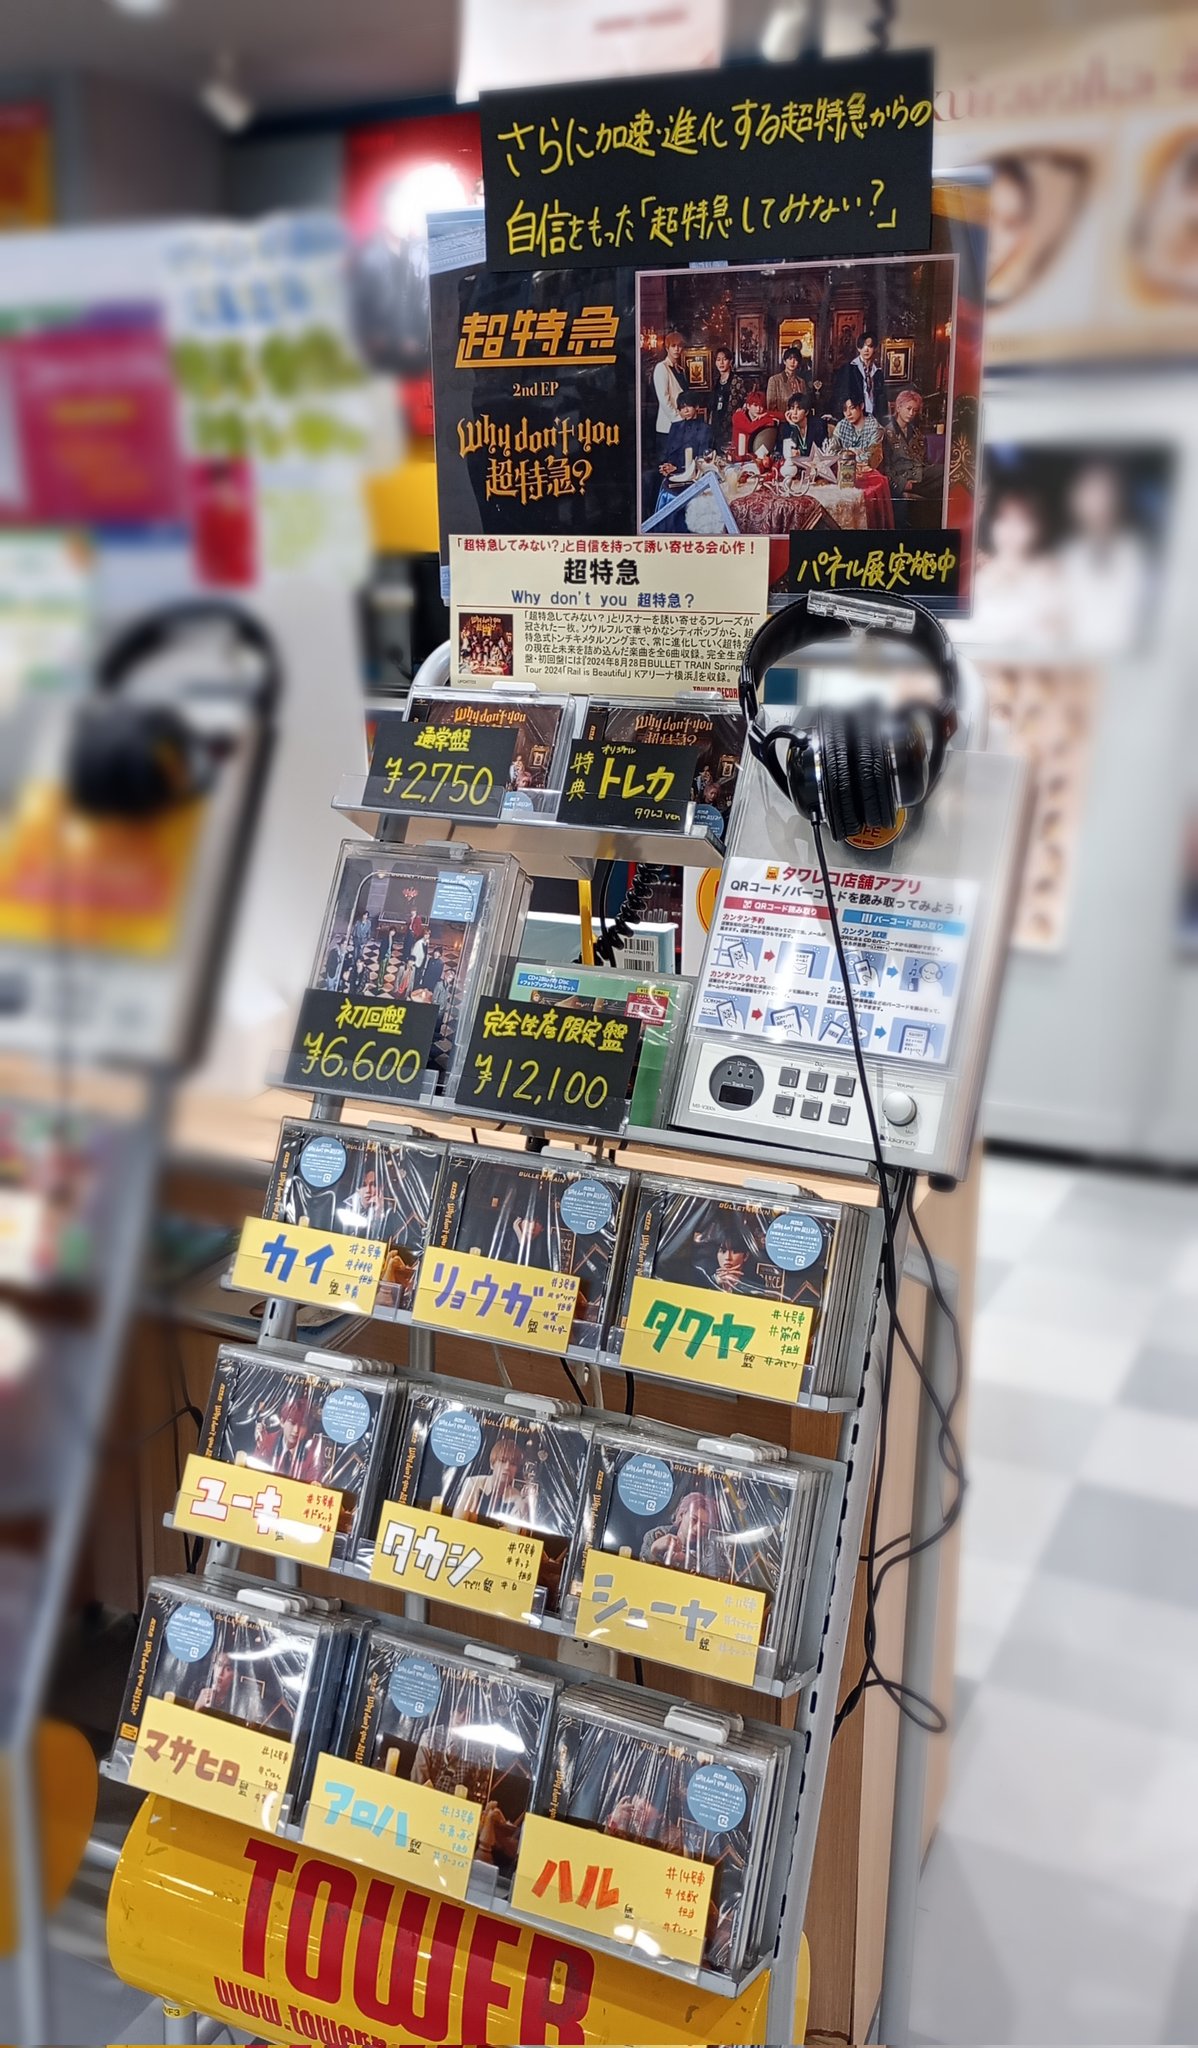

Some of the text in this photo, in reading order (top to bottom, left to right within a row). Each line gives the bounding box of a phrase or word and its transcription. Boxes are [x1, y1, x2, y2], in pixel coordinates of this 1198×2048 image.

[455, 306, 620, 368] 超特急
[512, 381, 560, 397] 2nd EP
[457, 413, 620, 459] Why don't you
[563, 558, 640, 585] 超特急
[797, 543, 956, 588] パネル展実施中
[511, 590, 695, 609] Why don't you 超特急？
[525, 665, 541, 674] Tour
[583, 667, 590, 676] is
[684, 661, 711, 670] TRAIN
[454, 706, 480, 724] Why
[414, 726, 474, 753] 通常盤
[383, 757, 494, 807] ¥2,750
[566, 750, 596, 802] 特典
[598, 757, 676, 802] トレカ
[783, 866, 923, 894] タワレコ店舗アプリ
[710, 970, 766, 984] カンタンアクセス
[829, 986, 876, 999] カンン検索
[335, 997, 407, 1036] 初回盤
[482, 1003, 629, 1054] 完全生産限定盤
[302, 1032, 421, 1084] ¥6,600
[474, 1053, 609, 1110] ¥12,100
[518, 1171, 543, 1180] BULLET
[262, 1233, 335, 1285] カイ
[433, 1263, 544, 1328] リョウガ
[643, 1299, 756, 1360] タクヤ
[771, 1309, 806, 1328] #4号車
[780, 1344, 801, 1356] 担当
[190, 1476, 282, 1534] ユーキ
[381, 1520, 483, 1588] タカシ
[592, 1574, 718, 1642] シューヤ
[144, 1729, 240, 1787] マサヒロ
[324, 1781, 408, 1848] アロハ
[531, 1859, 619, 1910] ハル
[665, 1866, 706, 1887] #14号車
[242, 1836, 596, 2046] TOWER
